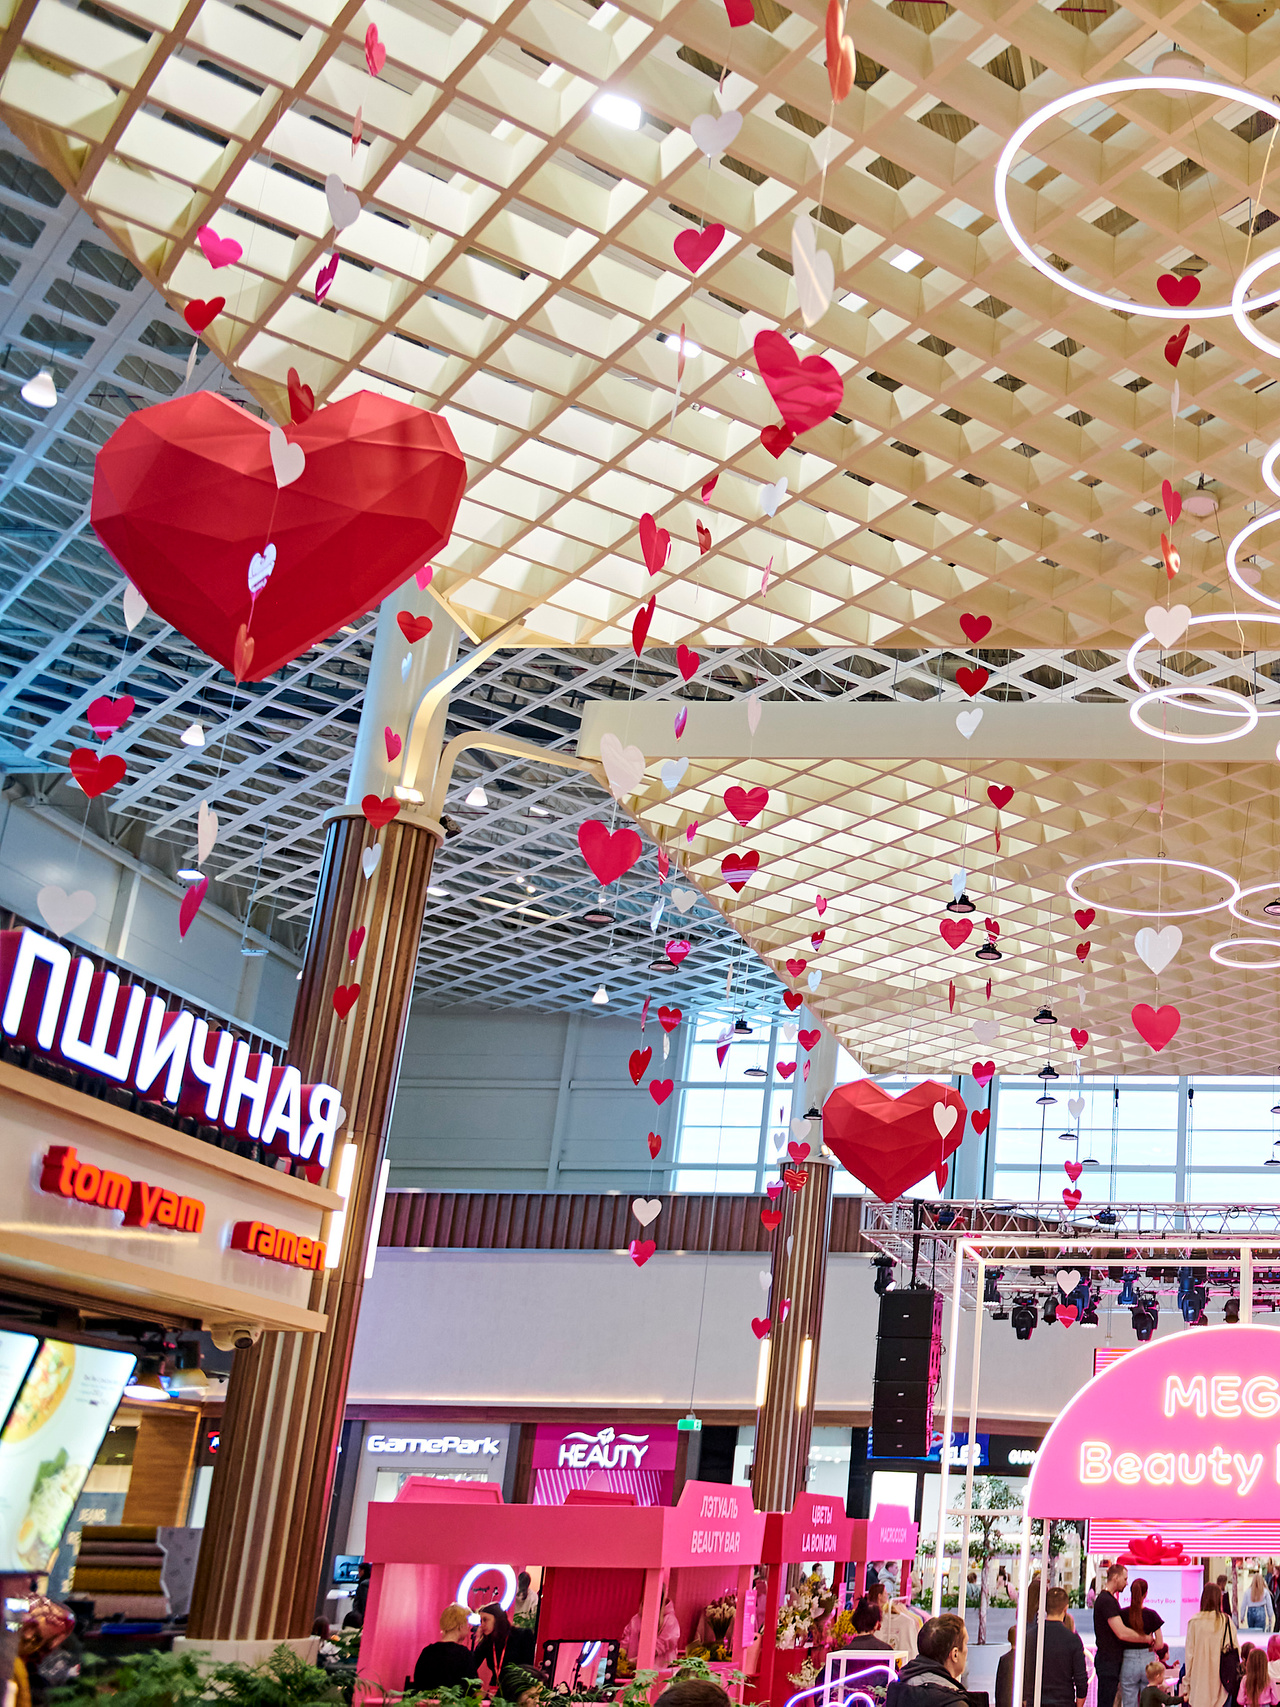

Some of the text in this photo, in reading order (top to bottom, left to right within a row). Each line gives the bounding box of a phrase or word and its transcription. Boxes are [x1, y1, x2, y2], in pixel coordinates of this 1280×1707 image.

[1, 927, 342, 1168] ПШИЧНАЯ
[57, 1146, 206, 1234] tom yam
[247, 1221, 327, 1271] ramen
[367, 1435, 500, 1455] GamePark
[1079, 1441, 1263, 1496] Beauty
[700, 1495, 739, 1519] ЛЭТУАЛЬ
[811, 1505, 833, 1527] ЦВЕТЫ
[691, 1530, 741, 1554] BEAUTY BAR
[802, 1533, 838, 1552] LA BON BON
